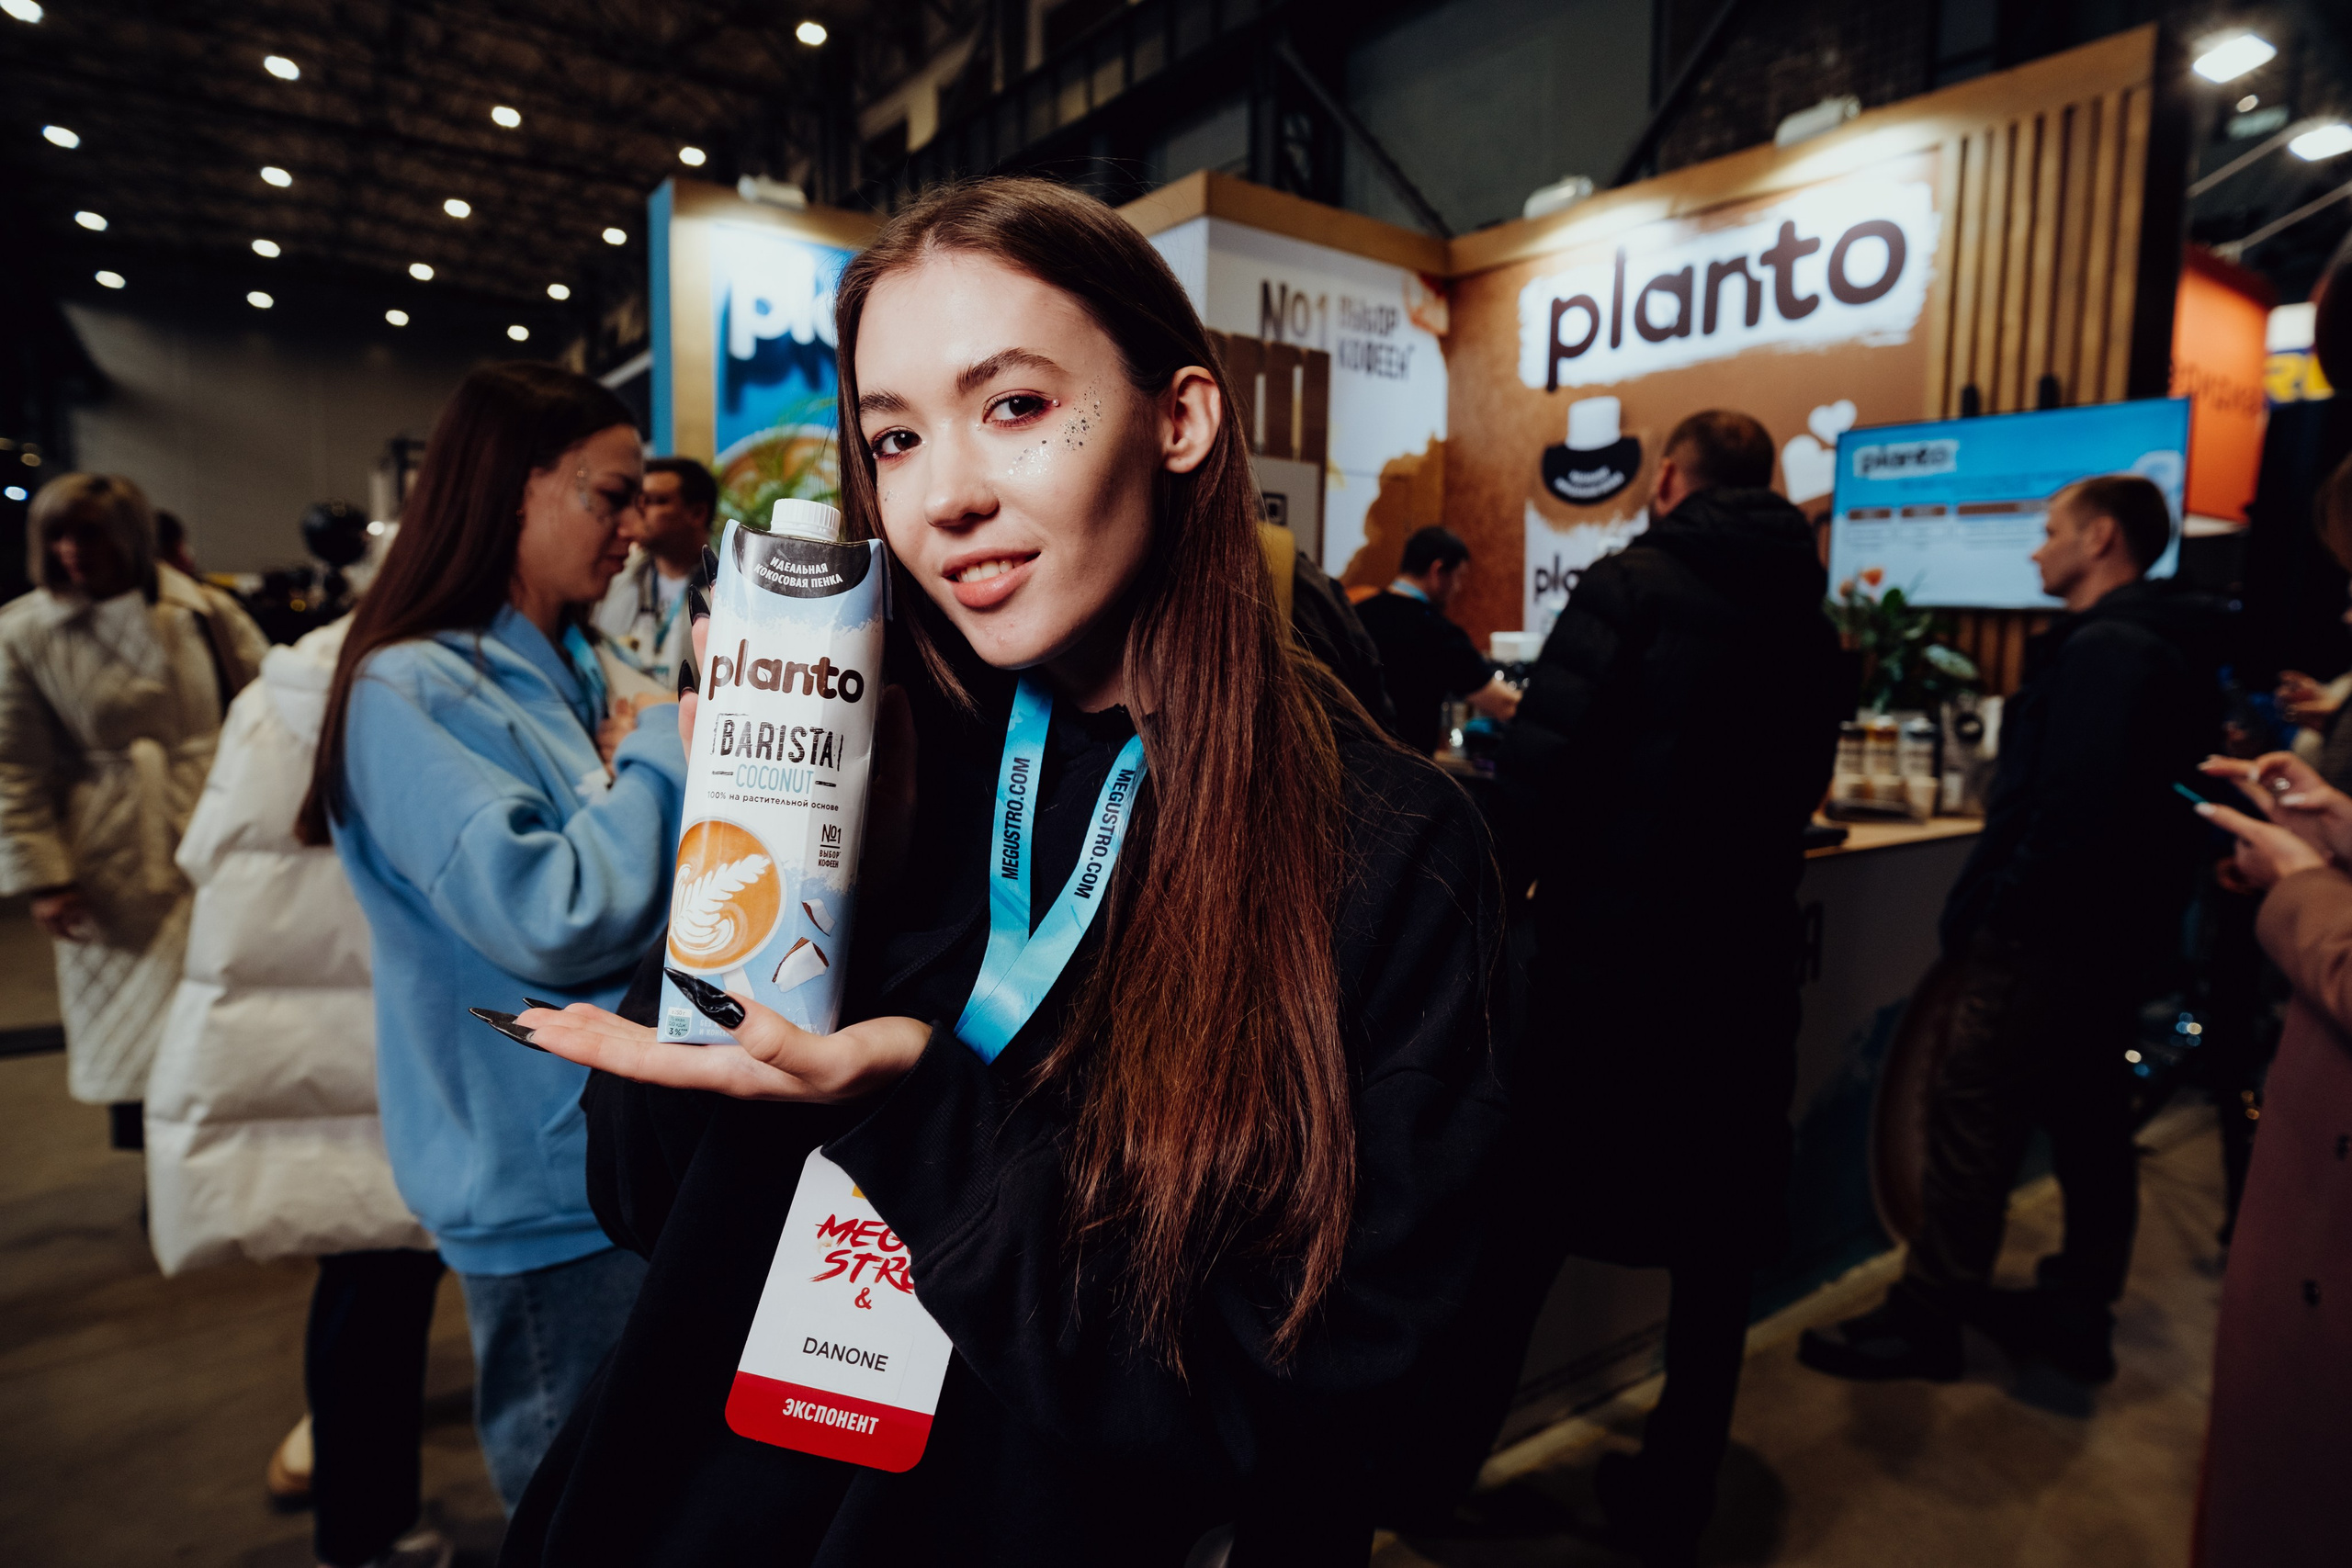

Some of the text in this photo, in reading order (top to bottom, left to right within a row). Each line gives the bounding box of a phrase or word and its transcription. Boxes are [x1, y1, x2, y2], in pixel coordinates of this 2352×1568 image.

[1545, 220, 1906, 393] planto
[753, 563, 843, 588] КОКОСОВАЯ ПЕНКА
[770, 557, 829, 575] ИДЕАЛЬНАЯ
[708, 638, 865, 704] planto
[720, 719, 833, 769] BARISTA
[736, 763, 814, 795] COCONUT
[707, 791, 726, 799] 100%
[742, 795, 808, 807] растительной
[811, 802, 839, 812] основе
[1001, 757, 1030, 880] MEGUSTRO.COM
[1074, 769, 1135, 899] MEGUSTRO.COM
[815, 1213, 912, 1256] MEG
[854, 1287, 872, 1310] &
[802, 1337, 888, 1372] DANONE
[783, 1398, 879, 1435] ЭКСПОНЕНТ
